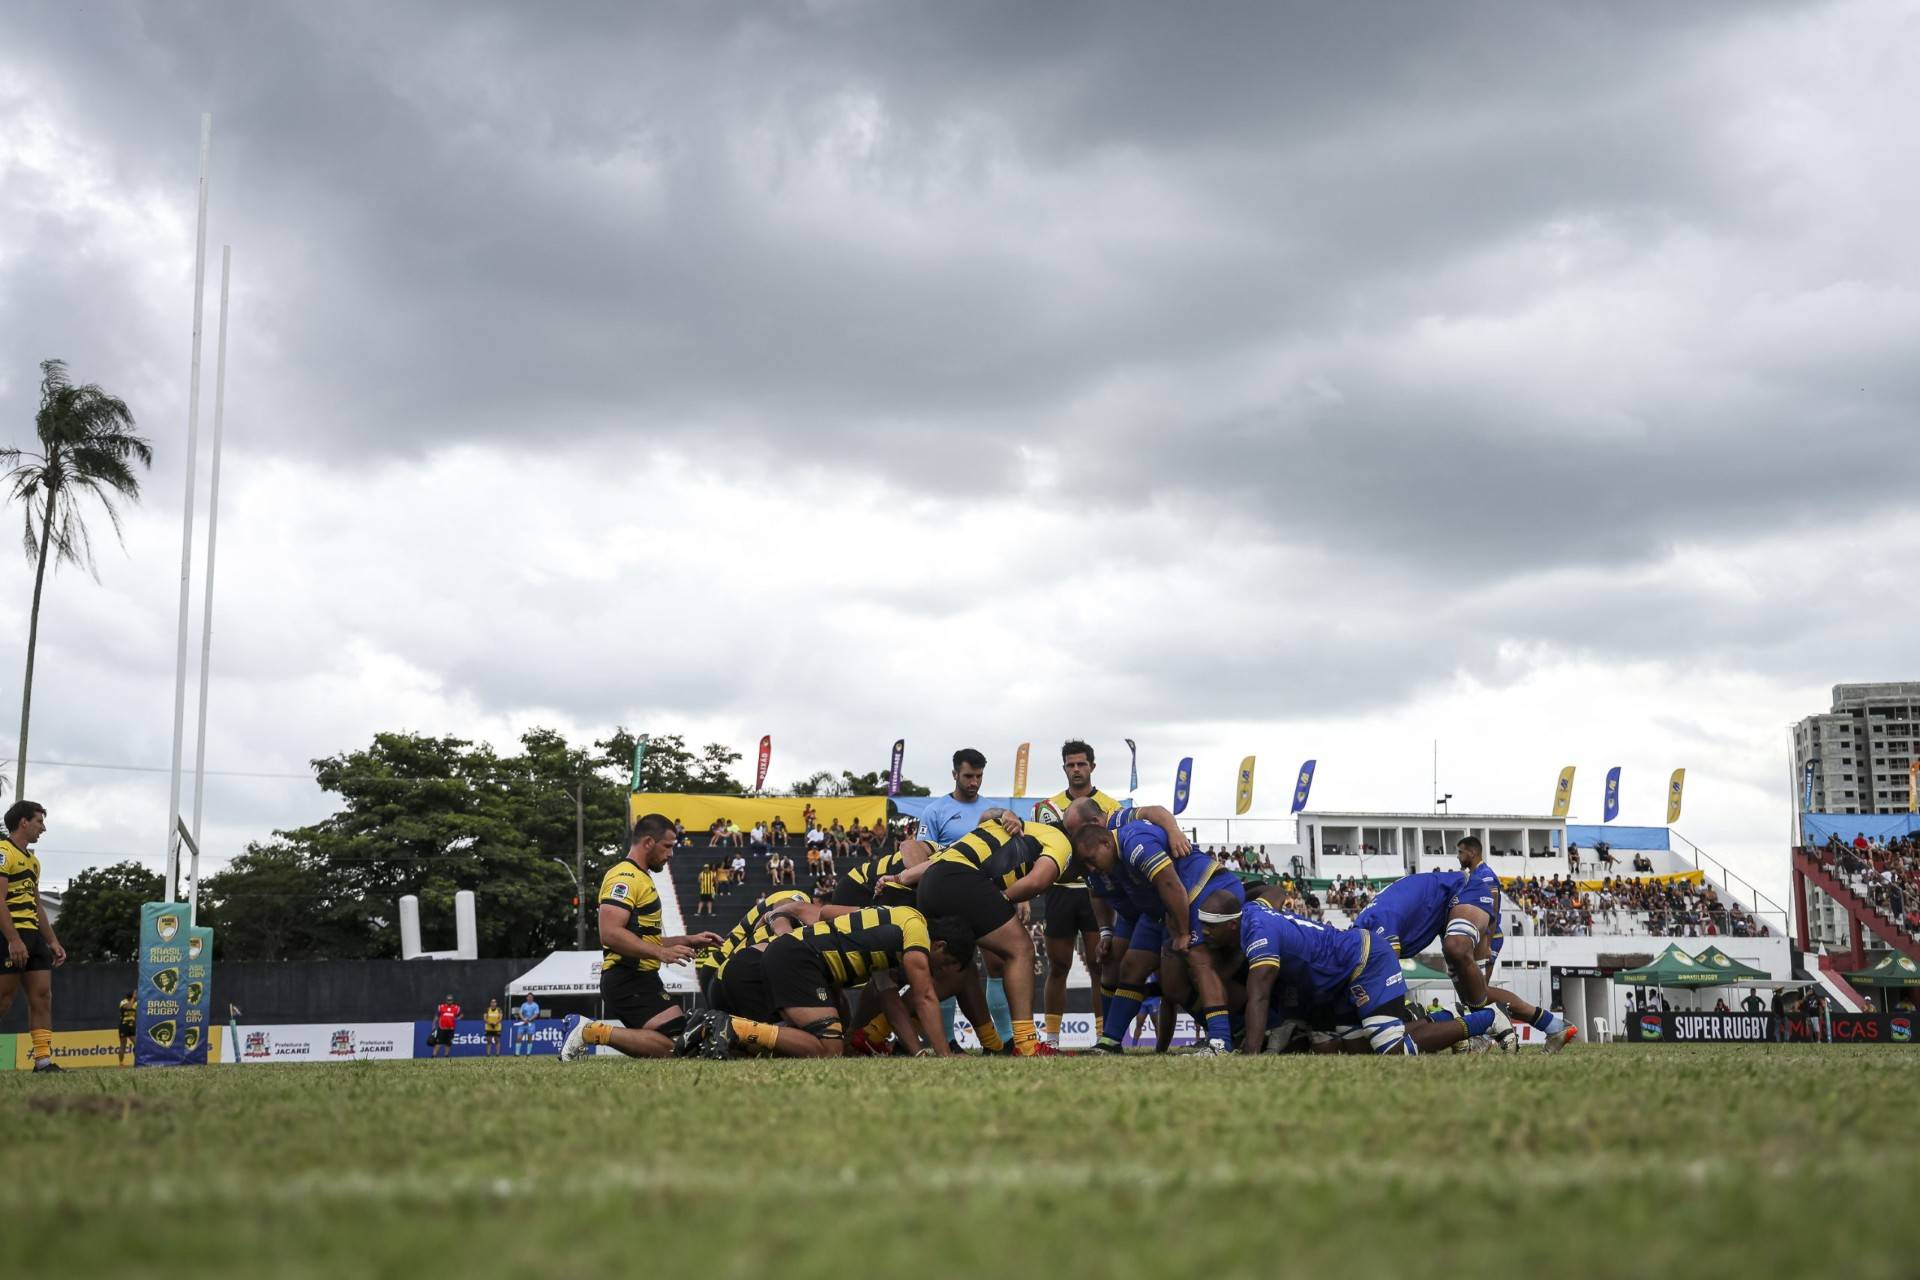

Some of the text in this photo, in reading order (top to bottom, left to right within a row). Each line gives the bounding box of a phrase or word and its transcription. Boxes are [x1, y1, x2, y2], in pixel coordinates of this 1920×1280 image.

[759, 752, 769, 780] PAIXÃO
[150, 947, 181, 955] BRASIL
[150, 954, 182, 963] RUGBY
[147, 1000, 179, 1008] BRASIL
[147, 1007, 180, 1016] RUGBY
[1675, 1016, 1721, 1039] SUPER
[1723, 1016, 1768, 1039] RUGBY
